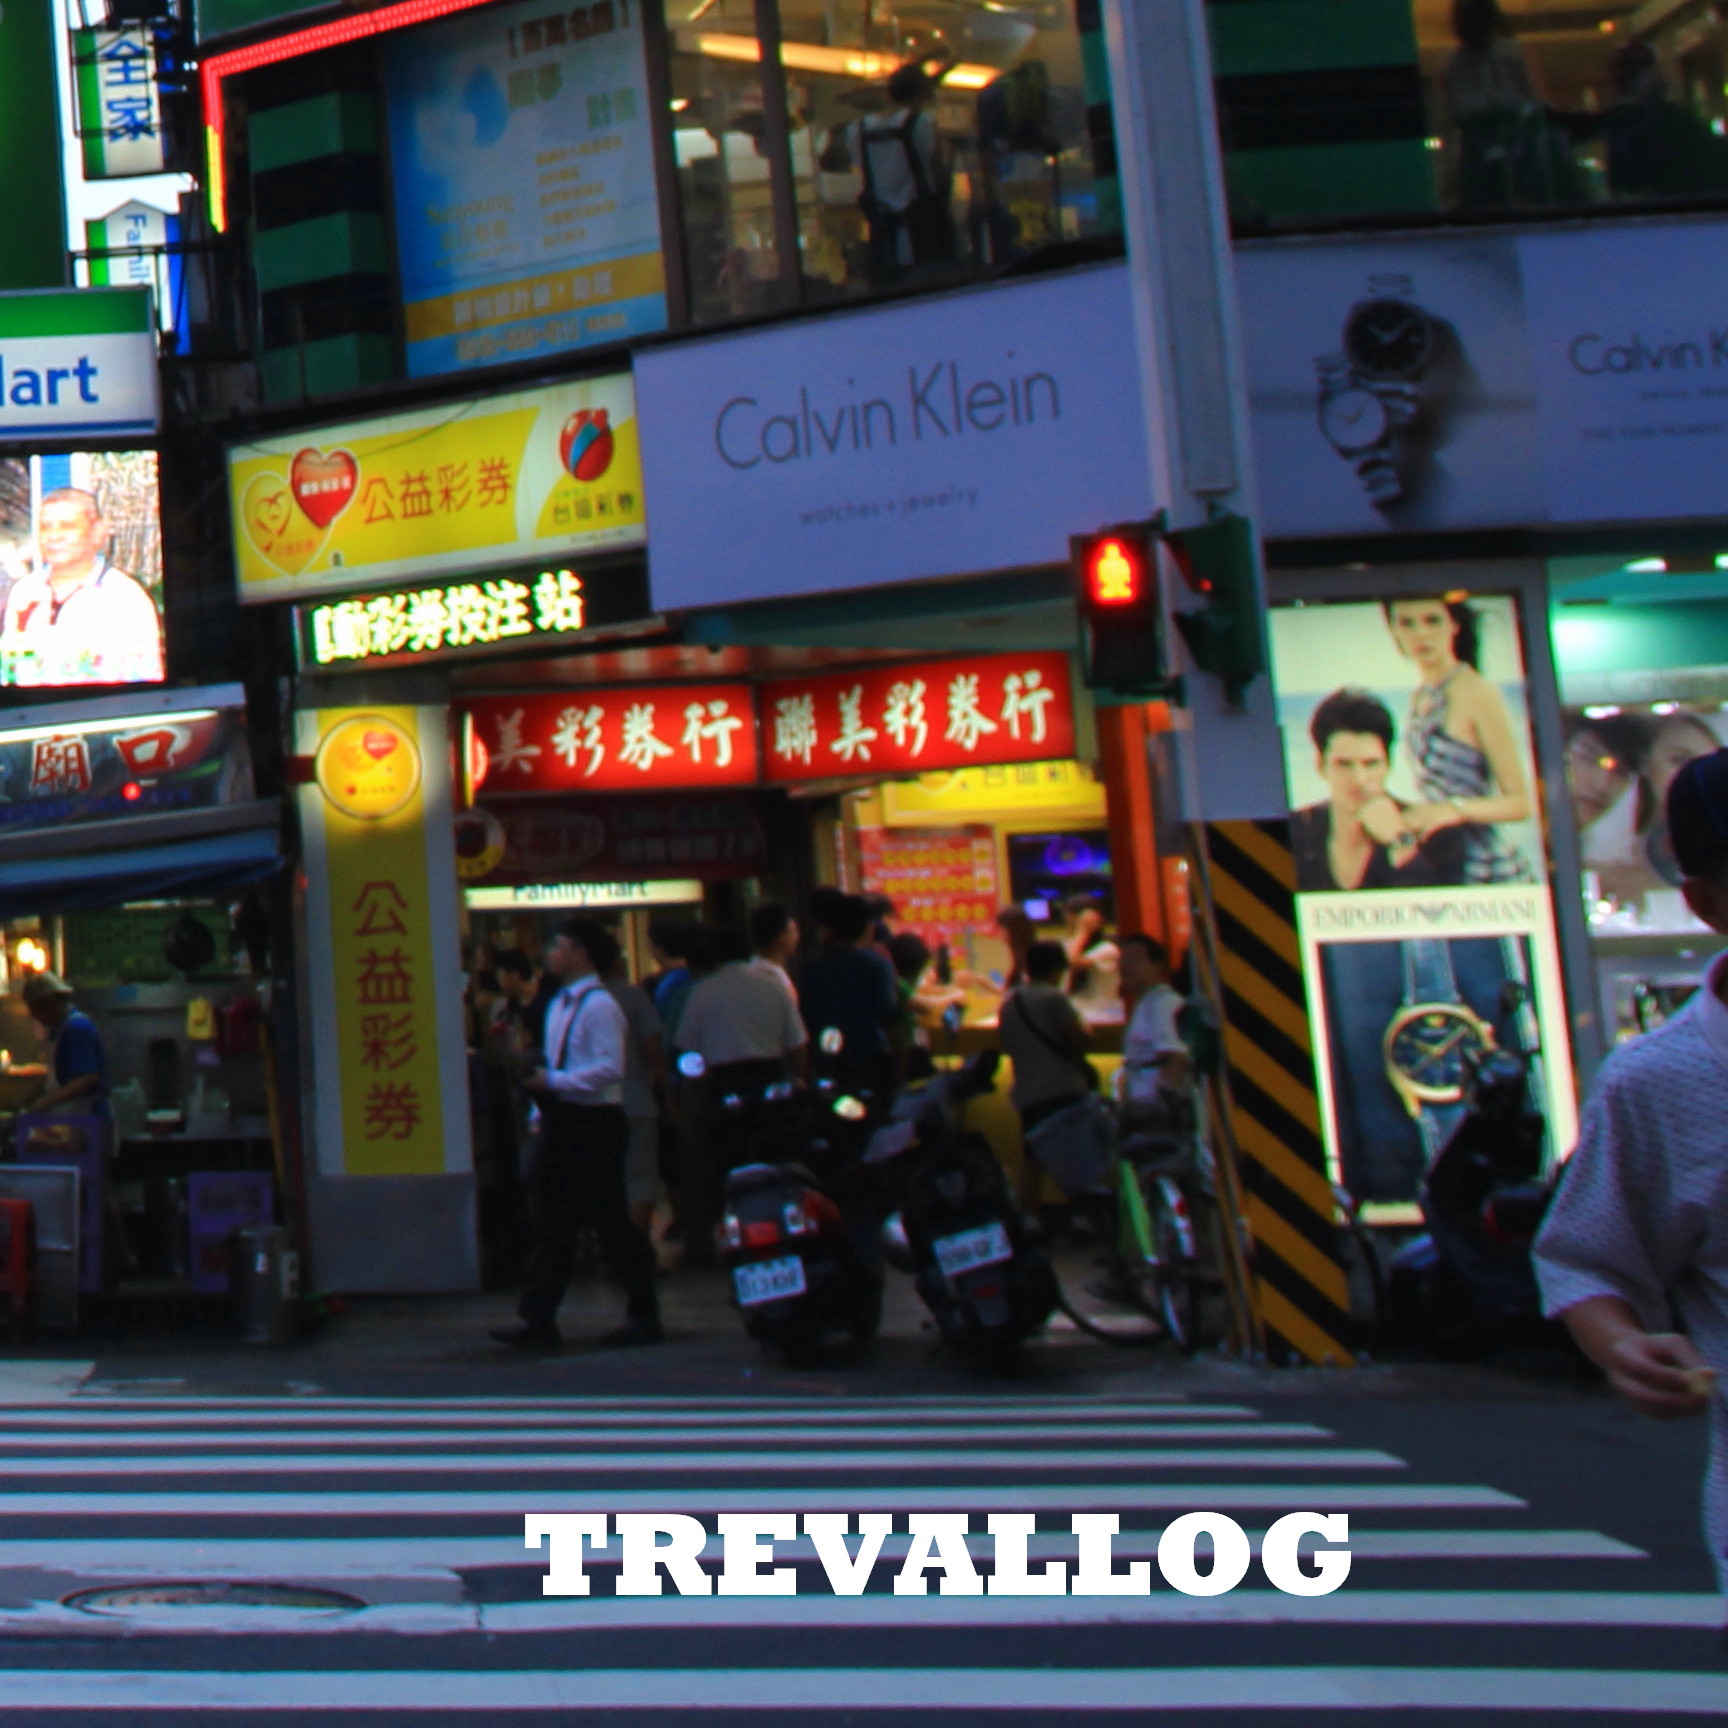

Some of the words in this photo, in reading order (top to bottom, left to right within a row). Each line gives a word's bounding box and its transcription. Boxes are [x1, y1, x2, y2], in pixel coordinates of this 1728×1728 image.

[1567, 333, 1704, 375] Calvin
[714, 377, 897, 472] Calvin
[908, 348, 1062, 440] Klein
[360, 456, 512, 525] 公益彩券
[30, 723, 179, 794] 廟口
[774, 669, 1056, 766] 聯美彩券行
[351, 879, 423, 1142] 公益彩券
